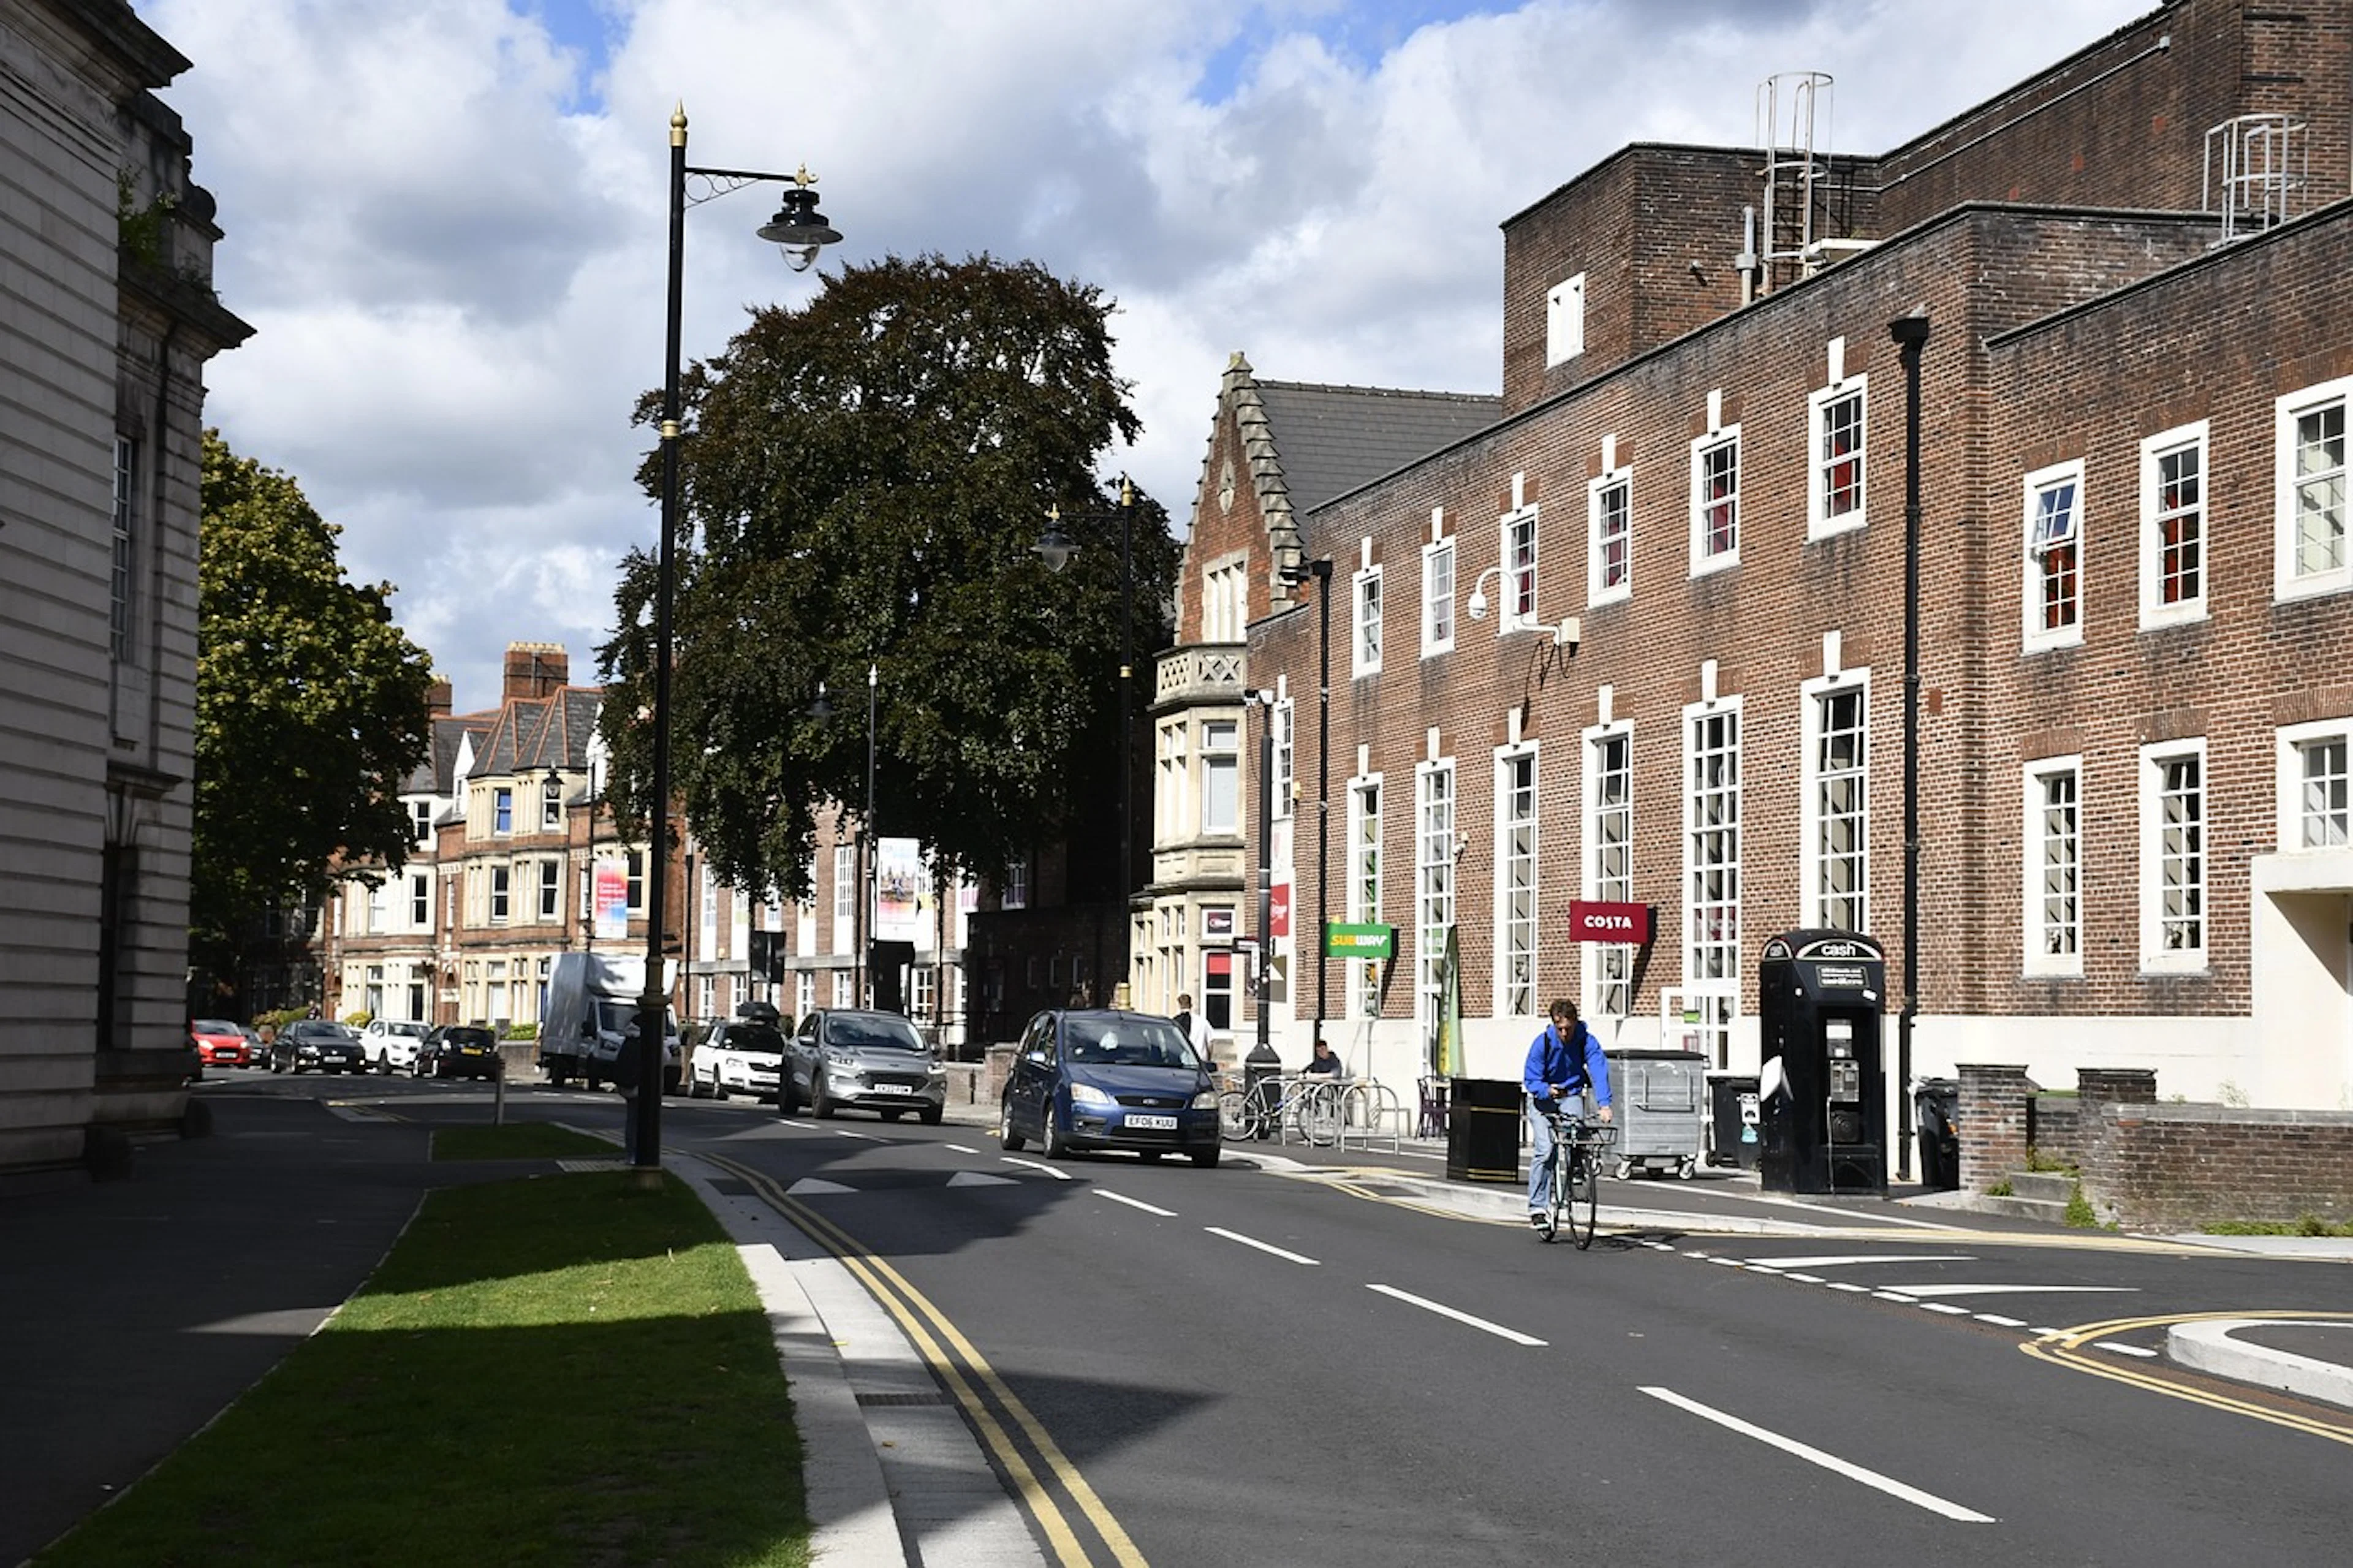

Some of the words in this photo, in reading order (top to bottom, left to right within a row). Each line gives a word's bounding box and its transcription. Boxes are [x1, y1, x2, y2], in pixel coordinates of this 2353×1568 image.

[1583, 915, 1633, 930] COSTA
[1330, 934, 1387, 947] SUBWAY
[1821, 943, 1856, 956] cash
[1156, 1119, 1173, 1127] KUU
